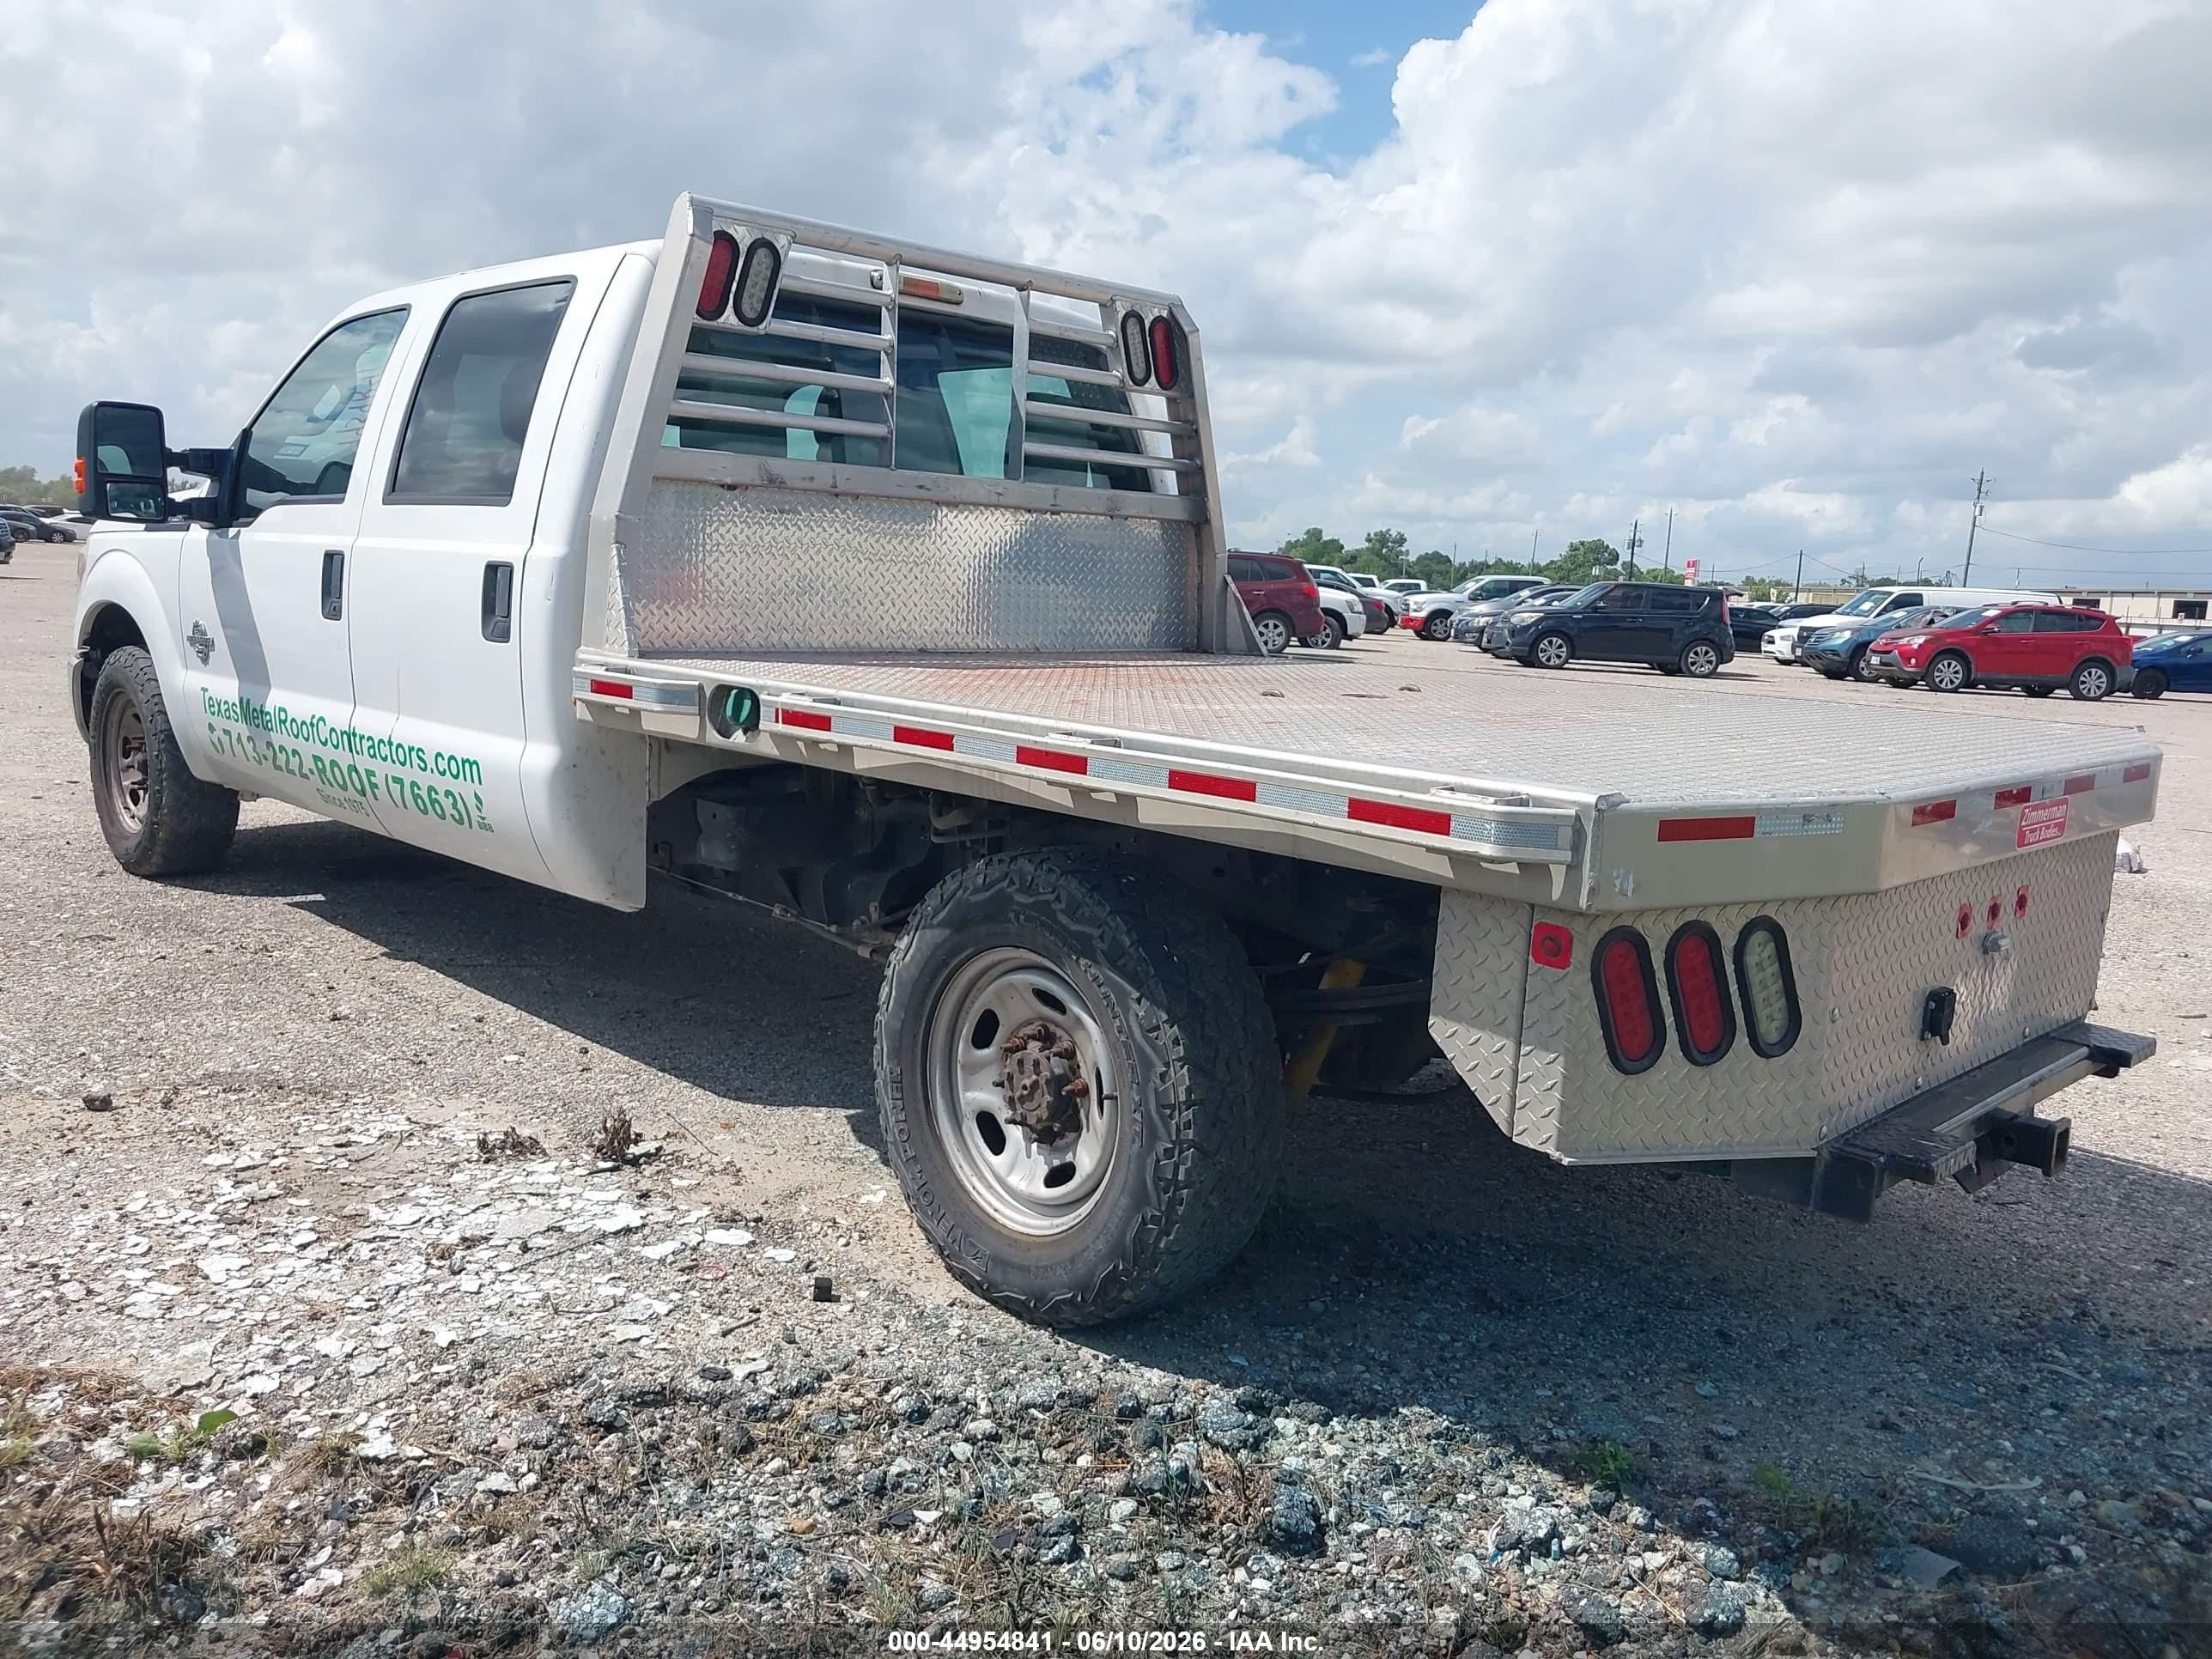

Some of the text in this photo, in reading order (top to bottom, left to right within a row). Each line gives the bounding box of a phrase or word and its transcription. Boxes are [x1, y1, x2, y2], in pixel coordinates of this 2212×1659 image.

[200, 686, 483, 786] TexasMetalRoofContractors.com
[222, 728, 473, 829] 713-222-ROOF (7663)
[2021, 805, 2067, 826] Zimmerman
[477, 820, 495, 833] BBB
[2024, 828, 2040, 844] Truck
